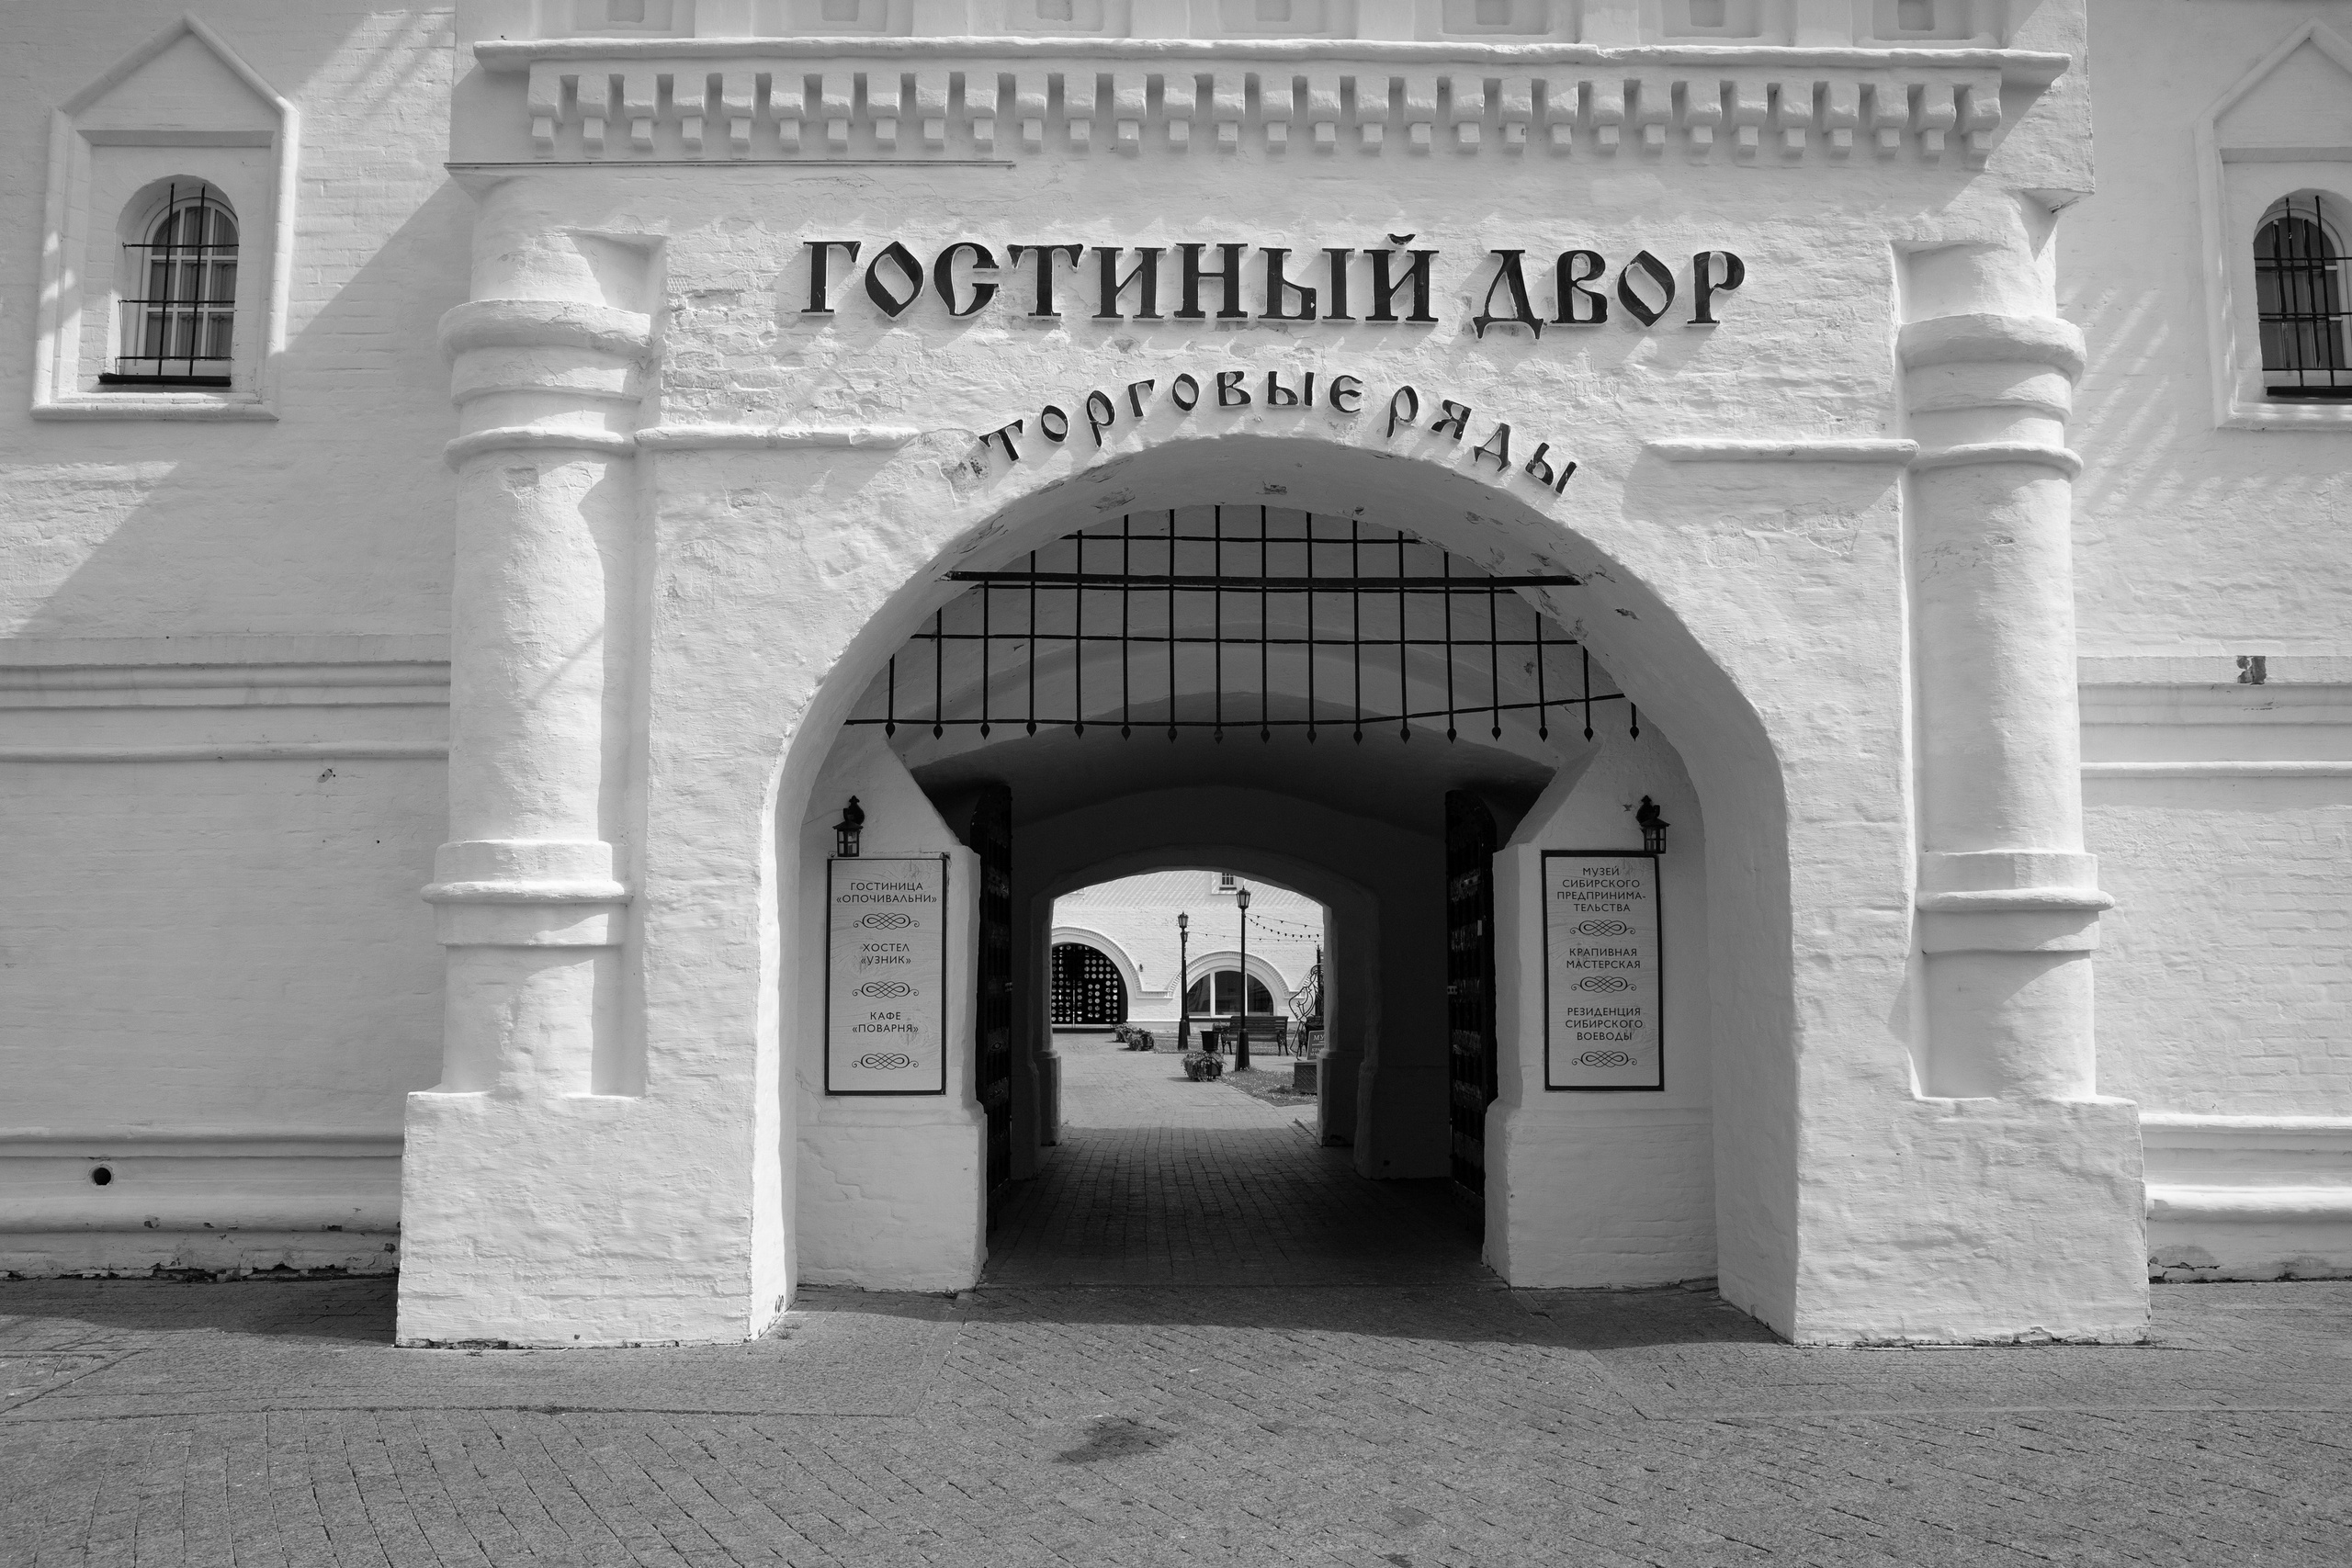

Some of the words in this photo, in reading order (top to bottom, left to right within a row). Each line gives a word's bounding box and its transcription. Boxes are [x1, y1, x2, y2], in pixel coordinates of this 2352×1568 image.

[802, 233, 1440, 322] ГОСТИНЫЙ
[1472, 249, 1746, 340] ДВОР
[1582, 865, 1620, 877] МУЗЕЙ
[850, 882, 923, 891] ГОСТИНИЦА
[1562, 879, 1640, 888] СИБИРСКОГО
[836, 894, 937, 903] «ОПОЧИВАЛЬНИ»
[1557, 891, 1646, 901] ПРЕДПРИНИМА-
[1573, 903, 1631, 912] ТЕЛЬСТВА
[863, 943, 910, 952] ХОСТЕЛ
[1569, 948, 1637, 956] КРАПИВНАЯ
[860, 955, 911, 965] «УЗНИК»
[1566, 960, 1641, 969] МАСТЕРСКАЯ
[870, 1011, 901, 1021] КАФЕ
[1567, 1007, 1641, 1017] РЕЗИДЕНЦИЯ
[852, 1023, 919, 1032] «ПОВАРНЯ»
[1565, 1019, 1644, 1029] СИБИРСКОГО
[1577, 1032, 1633, 1042] ВОЕВОДЫ
